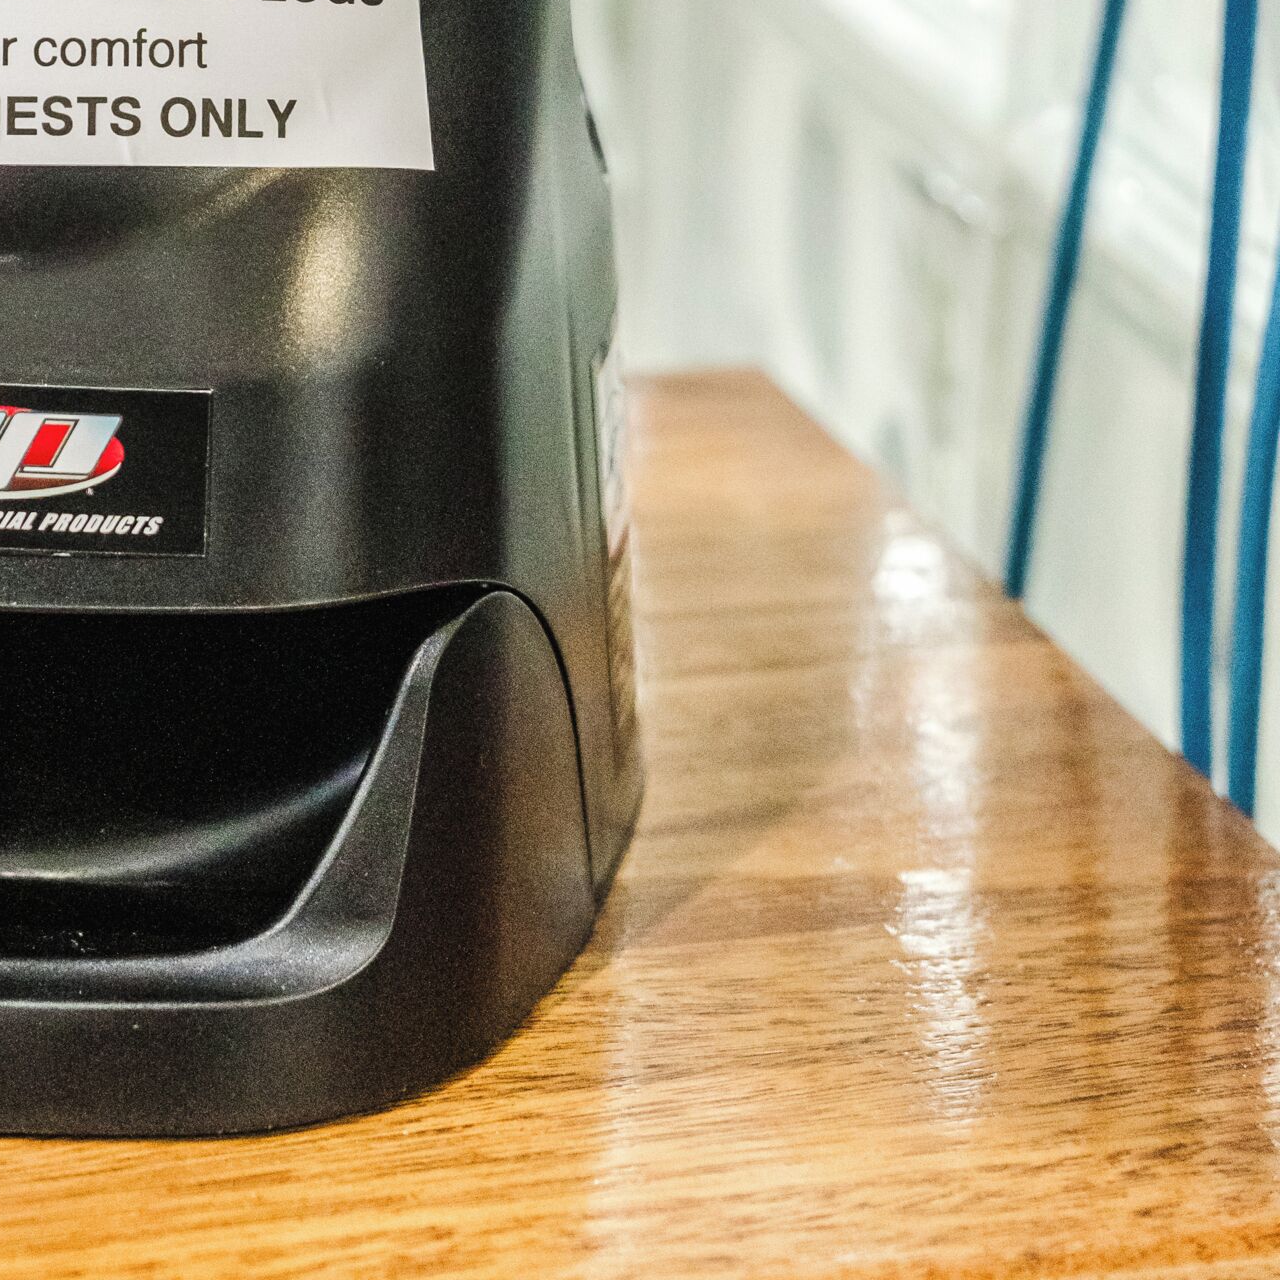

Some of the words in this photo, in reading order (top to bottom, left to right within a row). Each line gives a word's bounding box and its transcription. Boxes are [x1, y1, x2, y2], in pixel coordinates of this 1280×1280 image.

[33, 27, 208, 69] comfort
[159, 96, 298, 139] ONLY
[38, 512, 164, 536] PRODUCTS
